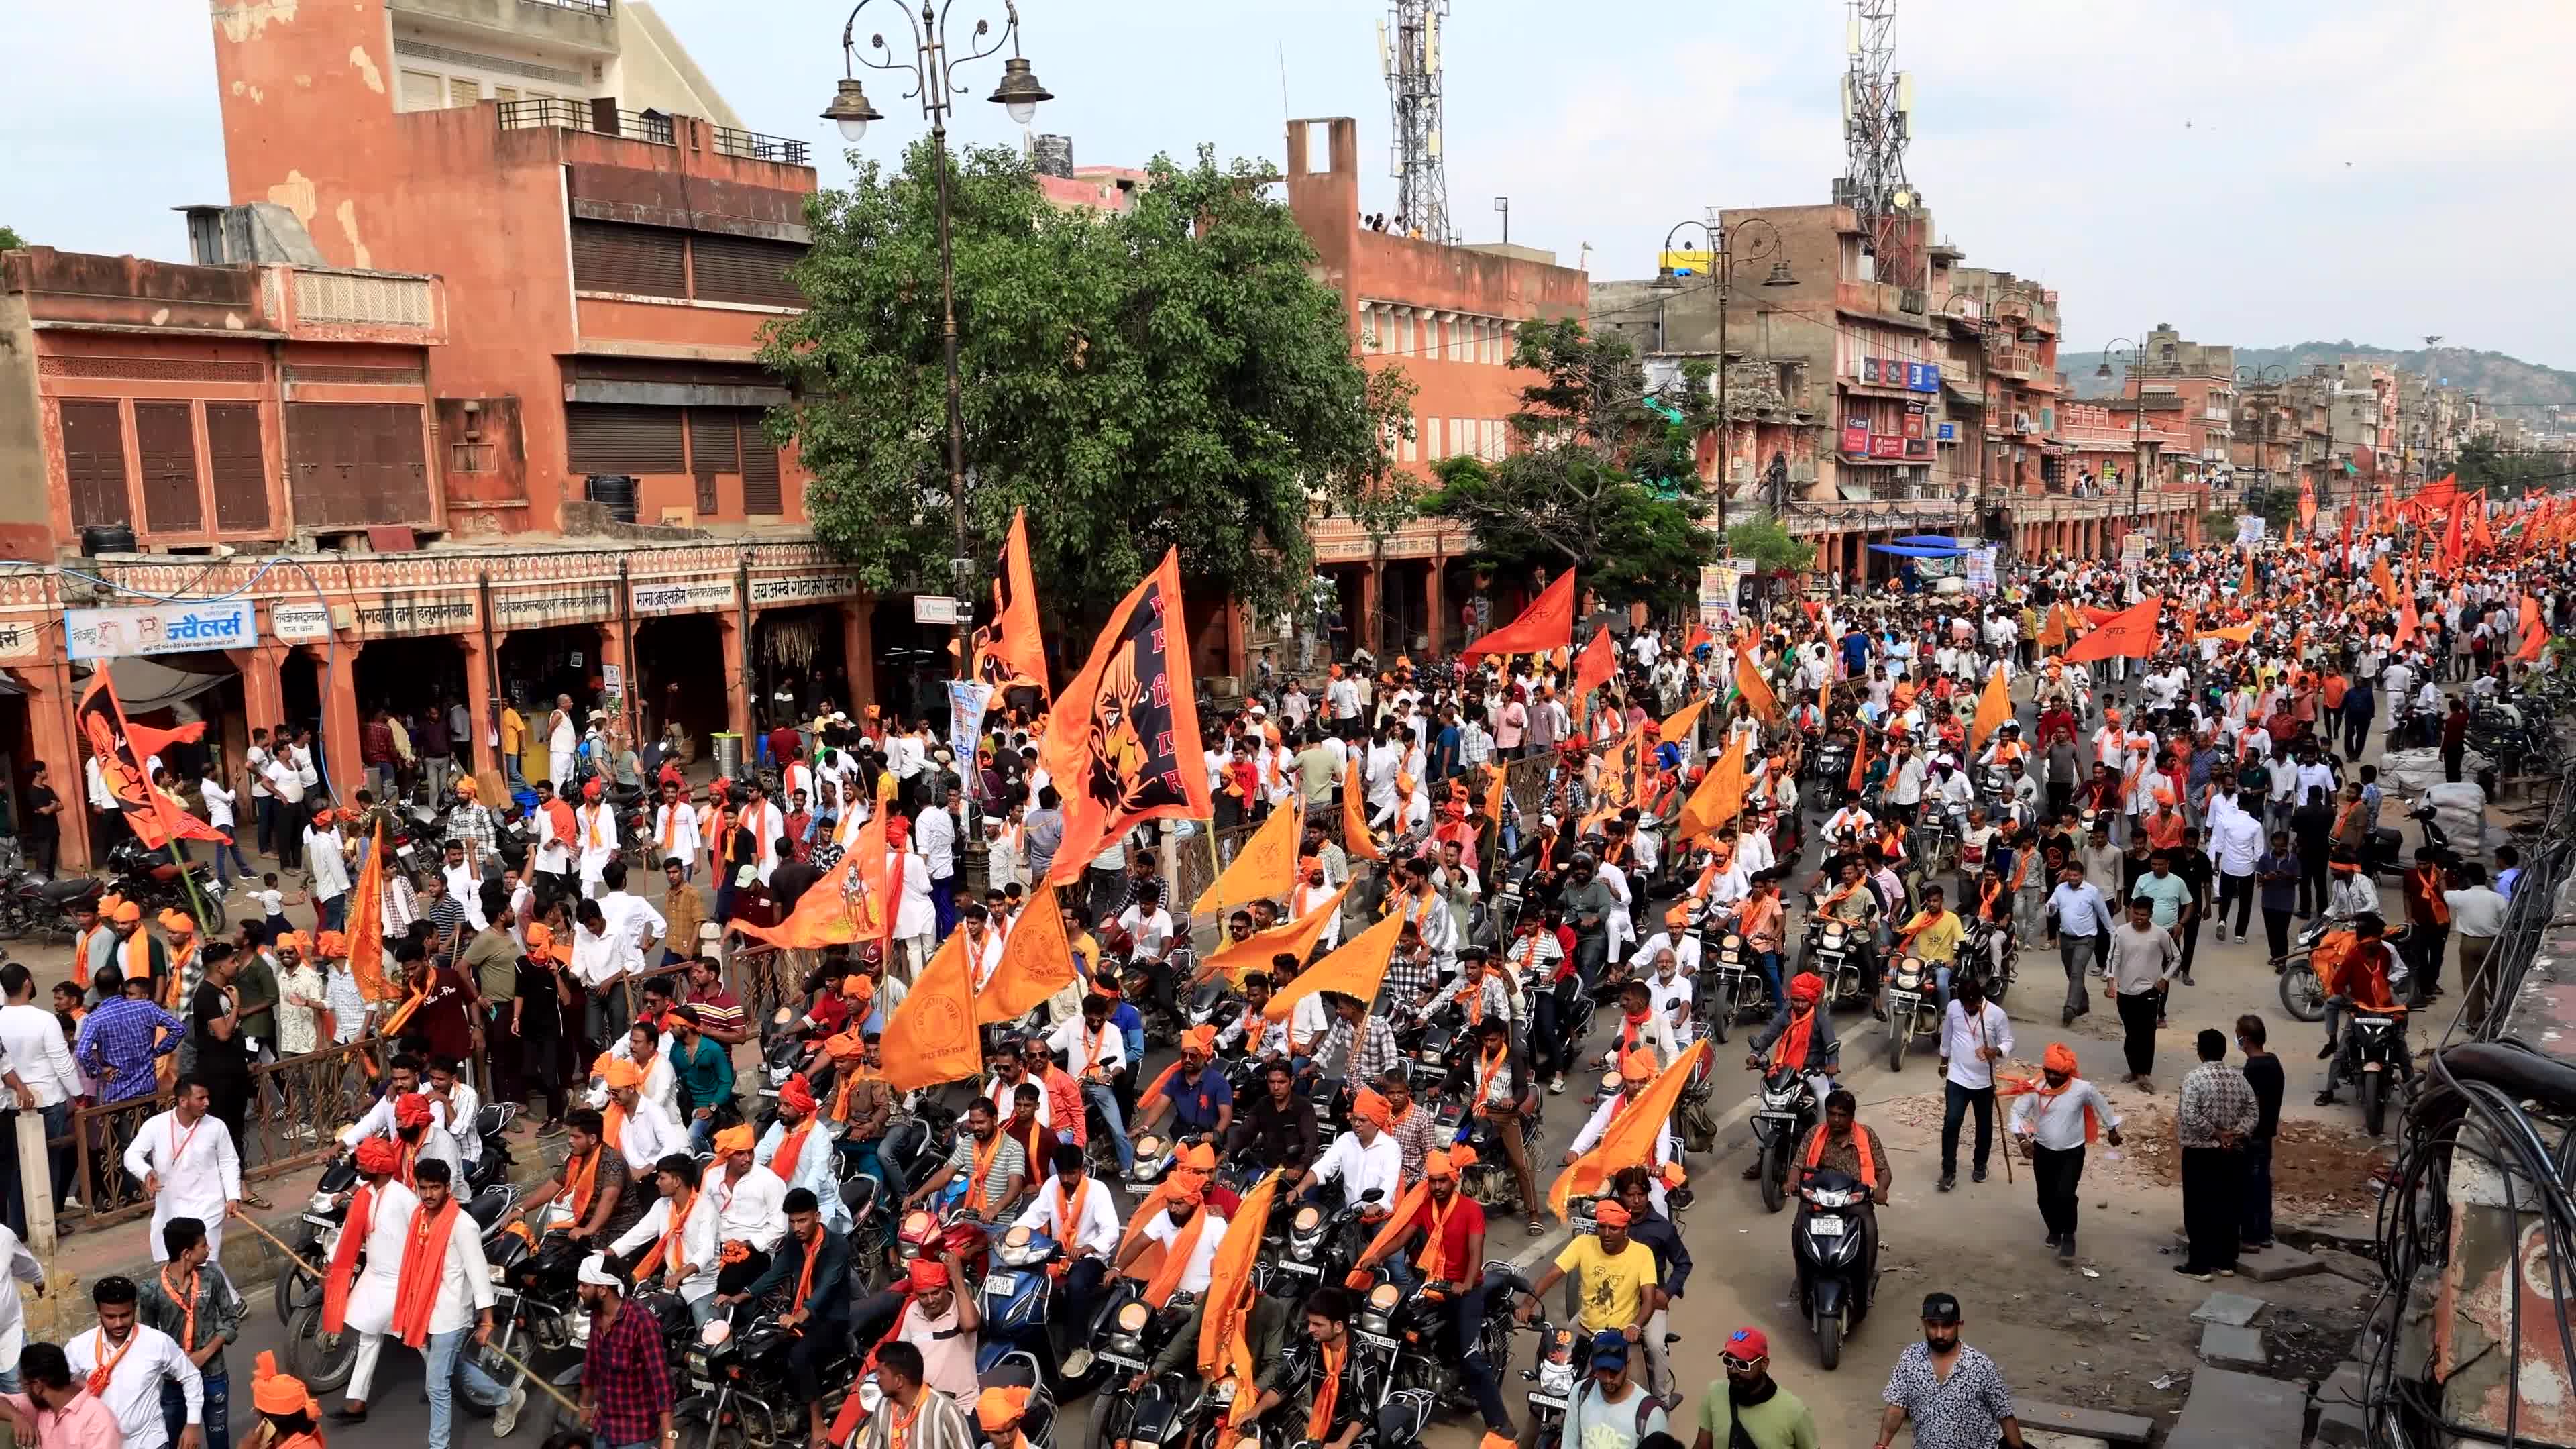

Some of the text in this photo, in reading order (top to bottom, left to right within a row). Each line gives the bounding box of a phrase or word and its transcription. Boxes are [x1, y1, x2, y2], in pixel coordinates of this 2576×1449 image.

[2041, 446, 2061, 455] HOTEL
[753, 583, 767, 600] जय
[166, 611, 241, 641] ज्वैलर्स
